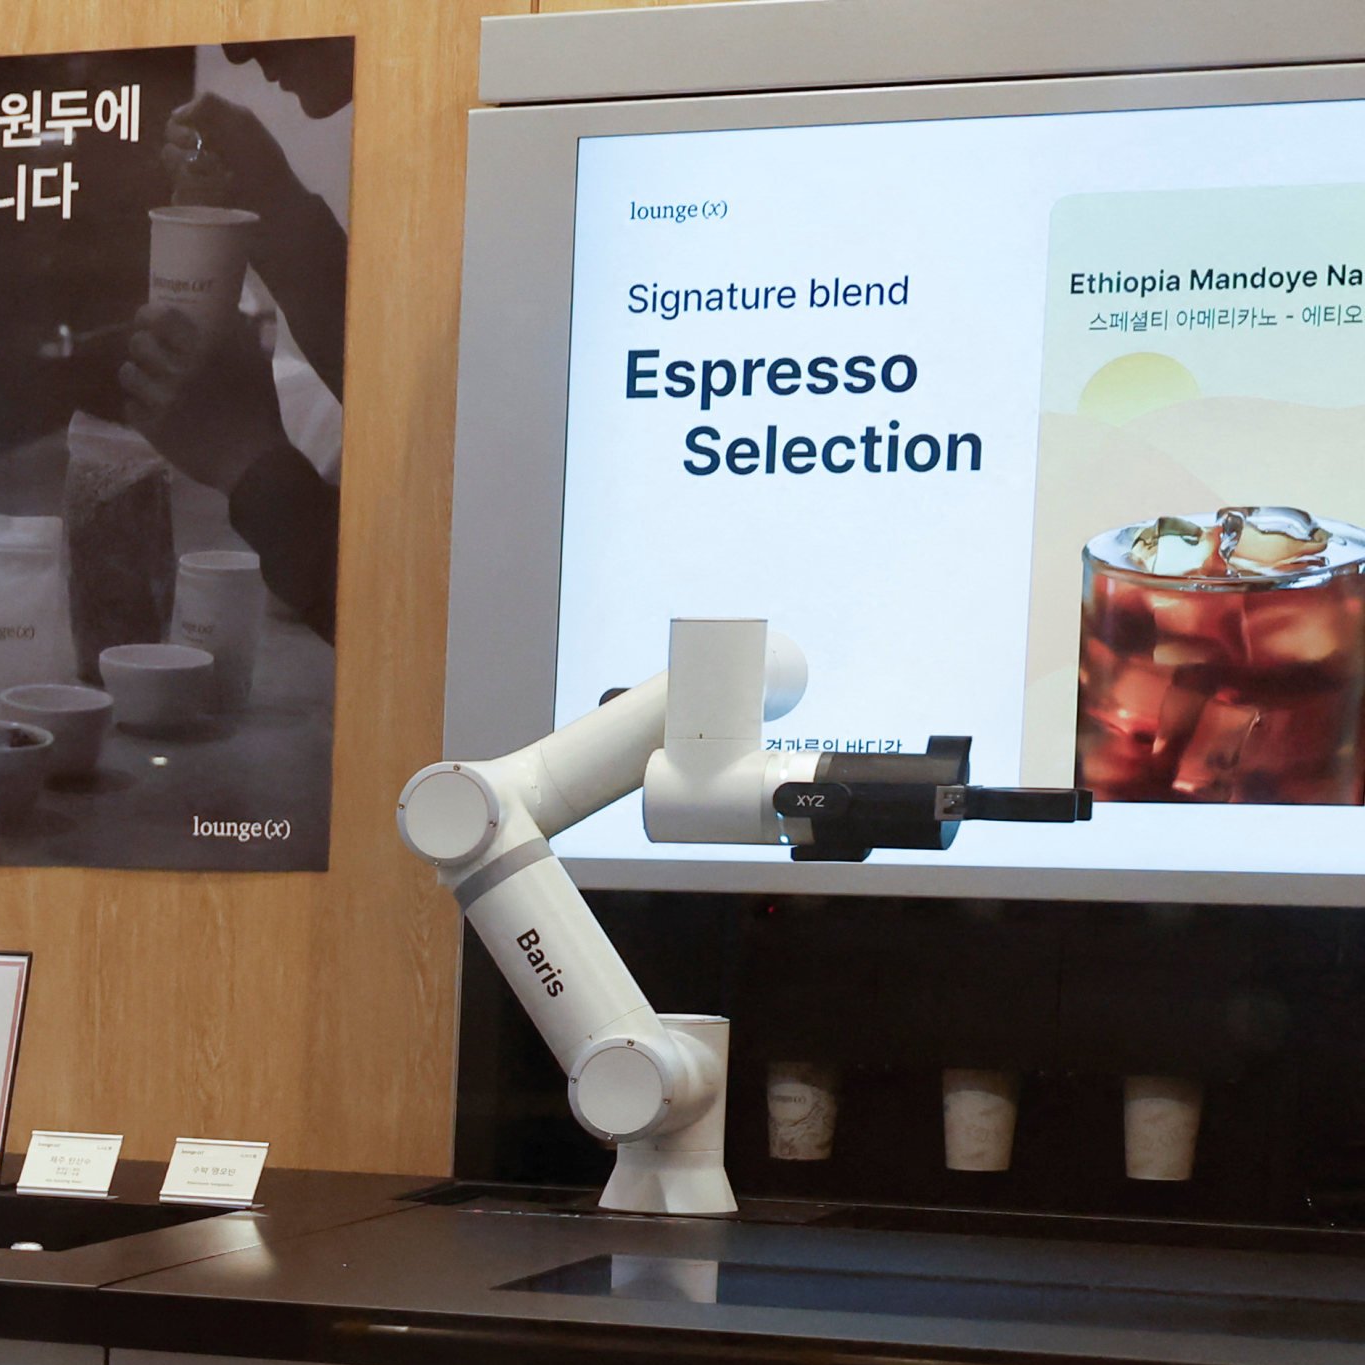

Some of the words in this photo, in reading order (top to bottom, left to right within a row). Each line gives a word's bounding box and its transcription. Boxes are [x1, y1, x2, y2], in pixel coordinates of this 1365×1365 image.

[627, 282, 796, 321] Signature
[809, 274, 910, 308] blend
[1070, 269, 1181, 298] Ethiopia
[1189, 266, 1318, 294] Mandoye
[1088, 309, 1169, 333] 스페셜티
[1176, 305, 1278, 330] 아메리카노
[625, 348, 919, 411] Espresso
[682, 419, 983, 477] Selection
[796, 794, 825, 808] XYZ
[516, 928, 564, 998] Baris
